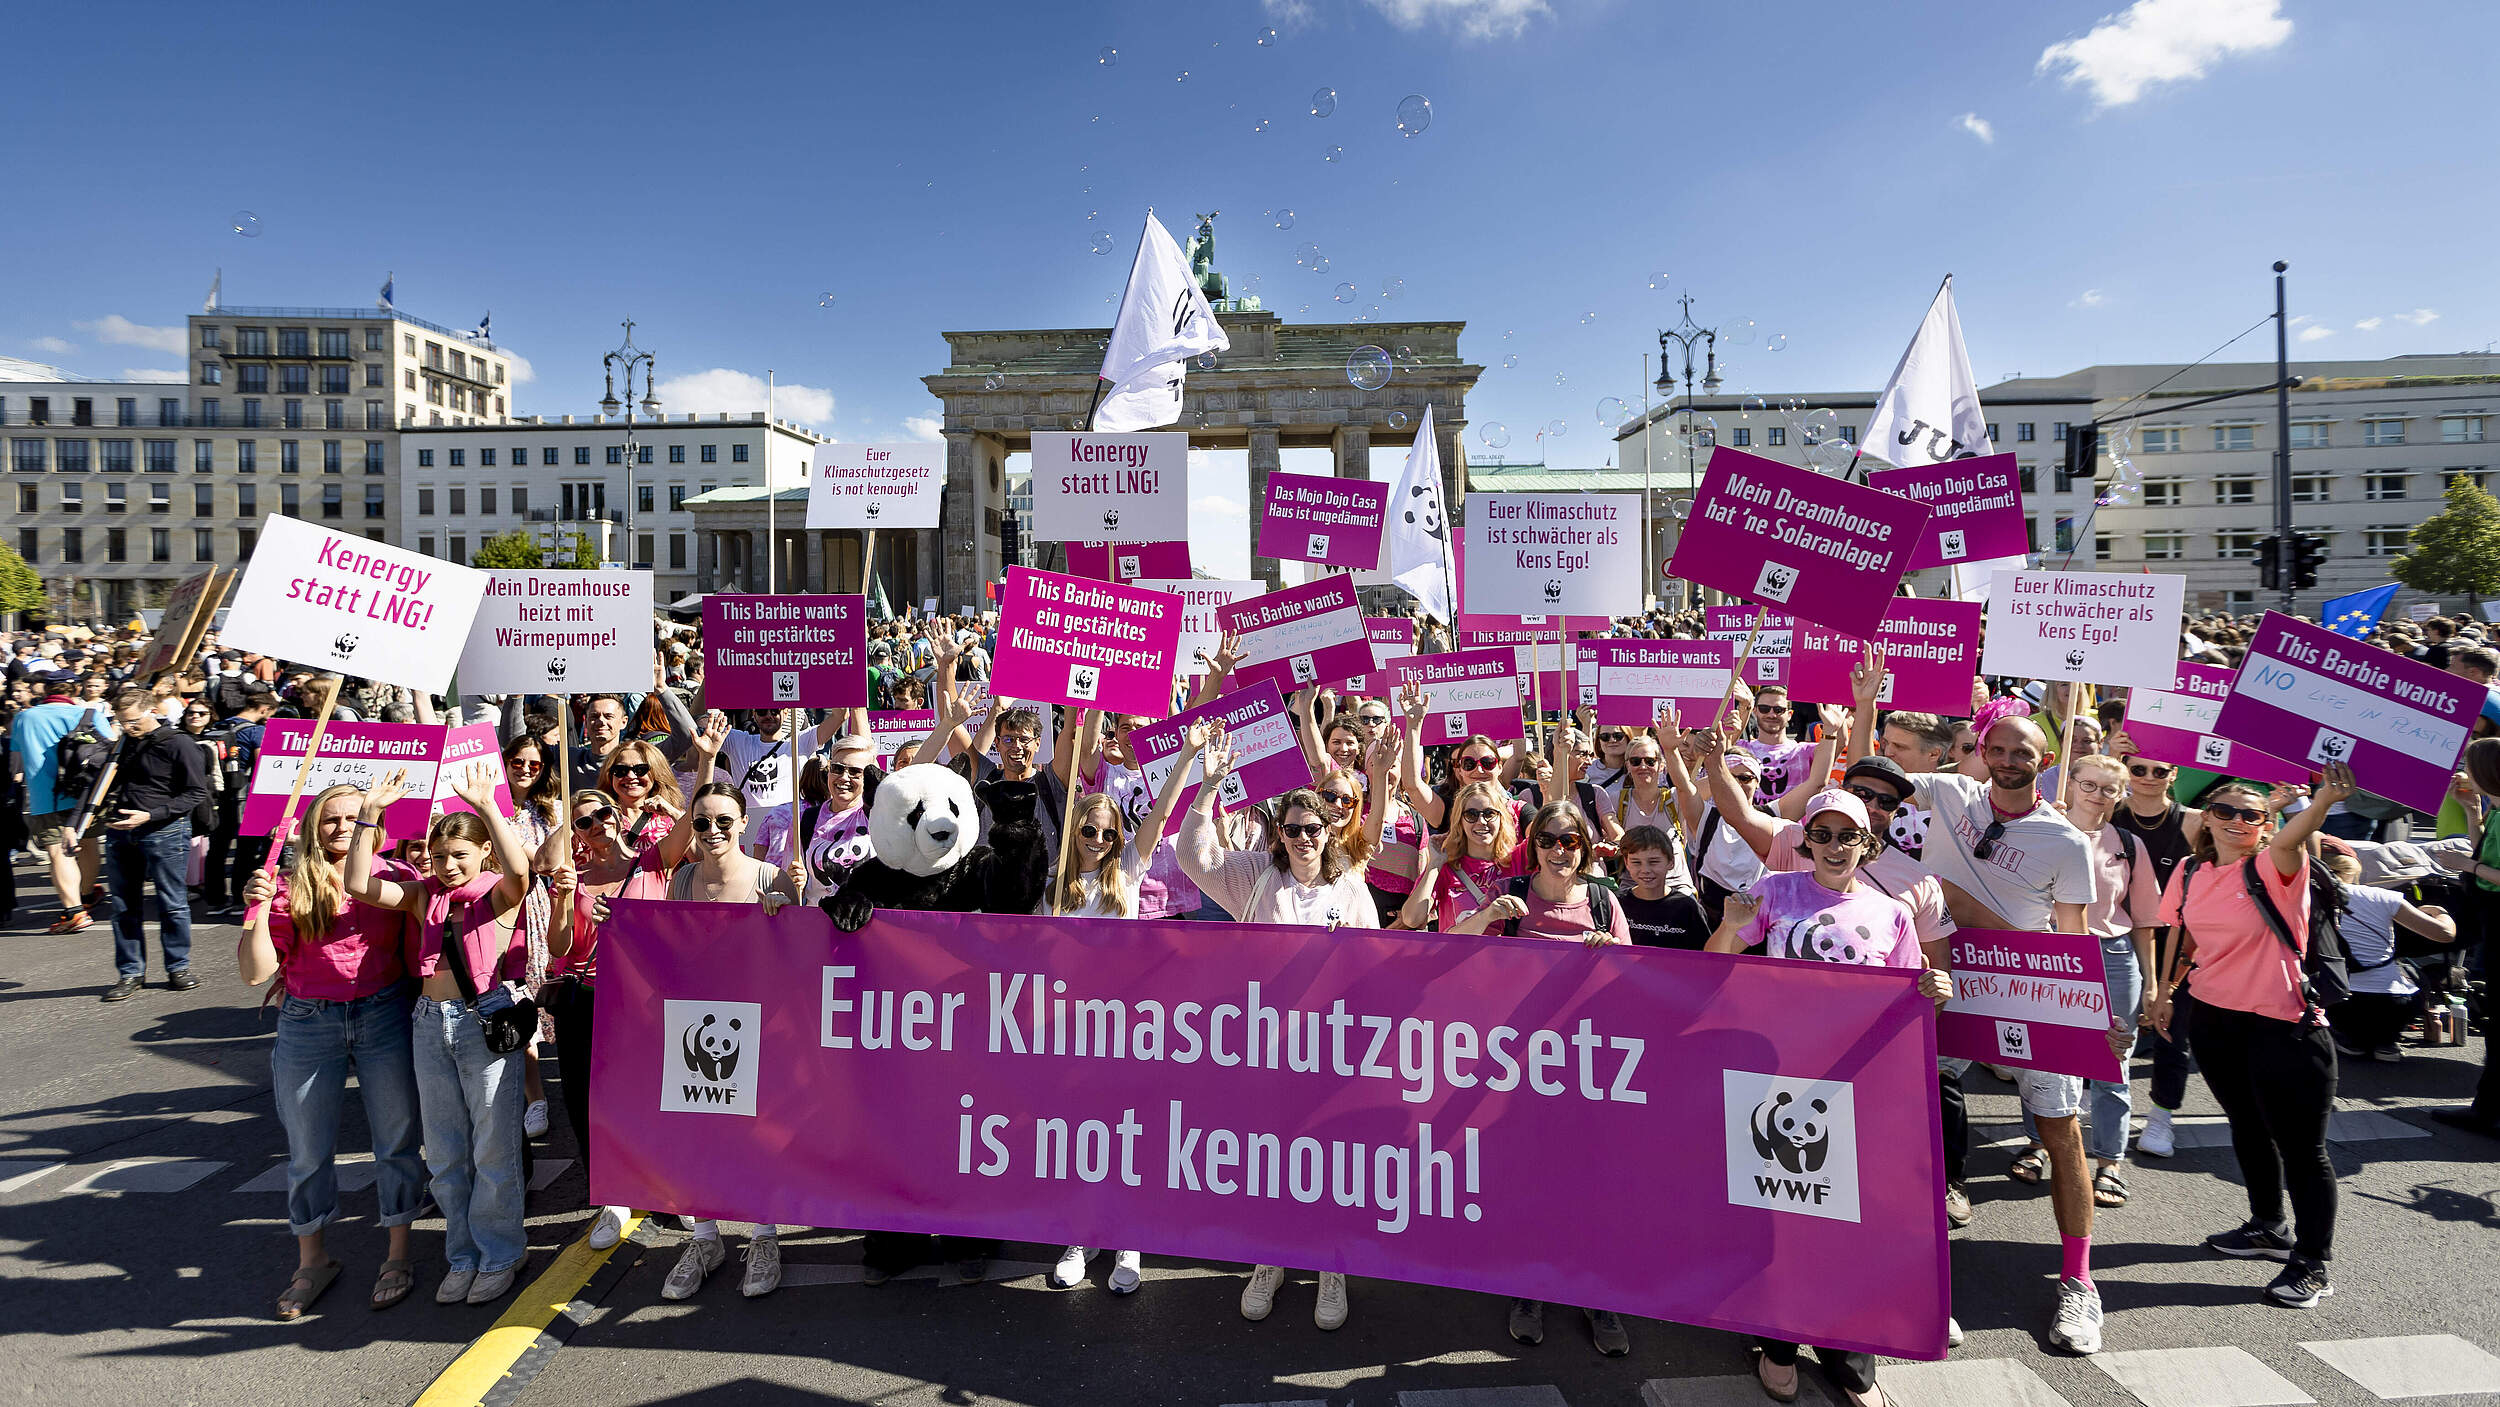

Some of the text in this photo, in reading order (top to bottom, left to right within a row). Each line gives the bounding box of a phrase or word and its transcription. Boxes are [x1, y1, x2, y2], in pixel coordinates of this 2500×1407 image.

[866, 448, 891, 461] Euer
[1071, 438, 1148, 468] Kenergy
[824, 465, 930, 481] Klimaschutzgesetz
[1061, 470, 1160, 495] statt LNG!
[832, 482, 918, 498] is not kenough!
[1275, 486, 1377, 509] Das Mojo Dojo Casa
[1909, 482, 1941, 500] Mojo
[1945, 477, 1974, 495] Dojo
[1977, 473, 2008, 490] Casa
[1268, 502, 1378, 528] Haus ist ungedämmt!
[1489, 501, 1617, 521] Euer Klimaschutz
[1725, 473, 1892, 542] Mein Dreamhouse
[1936, 490, 2015, 518] ungedämmt!
[1488, 526, 1618, 545] ist schwächer als
[1704, 497, 1737, 526] hat
[1771, 518, 1893, 573] Solaranlage!
[317, 536, 432, 595] Kenergy
[1516, 550, 1589, 573] Kens Ego!
[485, 577, 630, 596] Mein Dreamhouse
[1028, 576, 1164, 619] This Barbie wants
[1762, 586, 1782, 596] WWF
[2015, 576, 2155, 599] Euer Klimaschutz
[286, 578, 434, 631] statt LNG!
[519, 603, 594, 622] heizt mit
[721, 602, 847, 620] This Barbie wants
[1232, 611, 1260, 630] This
[1261, 602, 1303, 621] Barbie
[1304, 591, 1344, 611] wants
[2011, 600, 2154, 621] ist schwächer als
[1036, 608, 1147, 642] ein gestärktes
[1718, 614, 1742, 628] This
[1877, 616, 1956, 637] eamhouse
[496, 628, 616, 650] Wärmepumpe!
[734, 626, 835, 646] ein gestärktes
[1372, 629, 1402, 640] wants
[1472, 631, 1532, 643] This Barbie
[2039, 622, 2118, 644] Kens Ego!
[331, 651, 352, 660] WWF
[717, 648, 853, 669] Klimaschutzgesetz!
[1012, 627, 1162, 670] Klimaschutzgesetz!
[1578, 647, 1597, 659] rbie
[1610, 648, 1720, 665] This Barbie wants
[1804, 632, 1830, 651] hat
[1862, 638, 1964, 664] olaranlage!
[1398, 660, 1504, 682] This Barbie wants
[1626, 672, 1672, 686] CLEAN
[2276, 631, 2458, 714] This Barbie wants
[1449, 688, 1503, 701] KENERGY
[2254, 665, 2459, 751] NO LIFE IN PLASTIC
[878, 718, 906, 729] Barbie
[908, 718, 935, 729] wants
[1146, 699, 1270, 755] This wants
[321, 733, 374, 754] Barbie
[378, 740, 428, 756] wants
[750, 782, 777, 793] WWF
[1227, 793, 1241, 802] WWF
[1964, 943, 2021, 968] Barbie
[2025, 952, 2084, 974] wants
[1959, 976, 2104, 1013] KENS, NO HOT WORLD
[820, 965, 1647, 1104] Euer Klimaschutzgesetz
[682, 1085, 737, 1104] WWF
[958, 1094, 1482, 1234] is not kenough!
[1754, 1176, 1831, 1205] WWF
